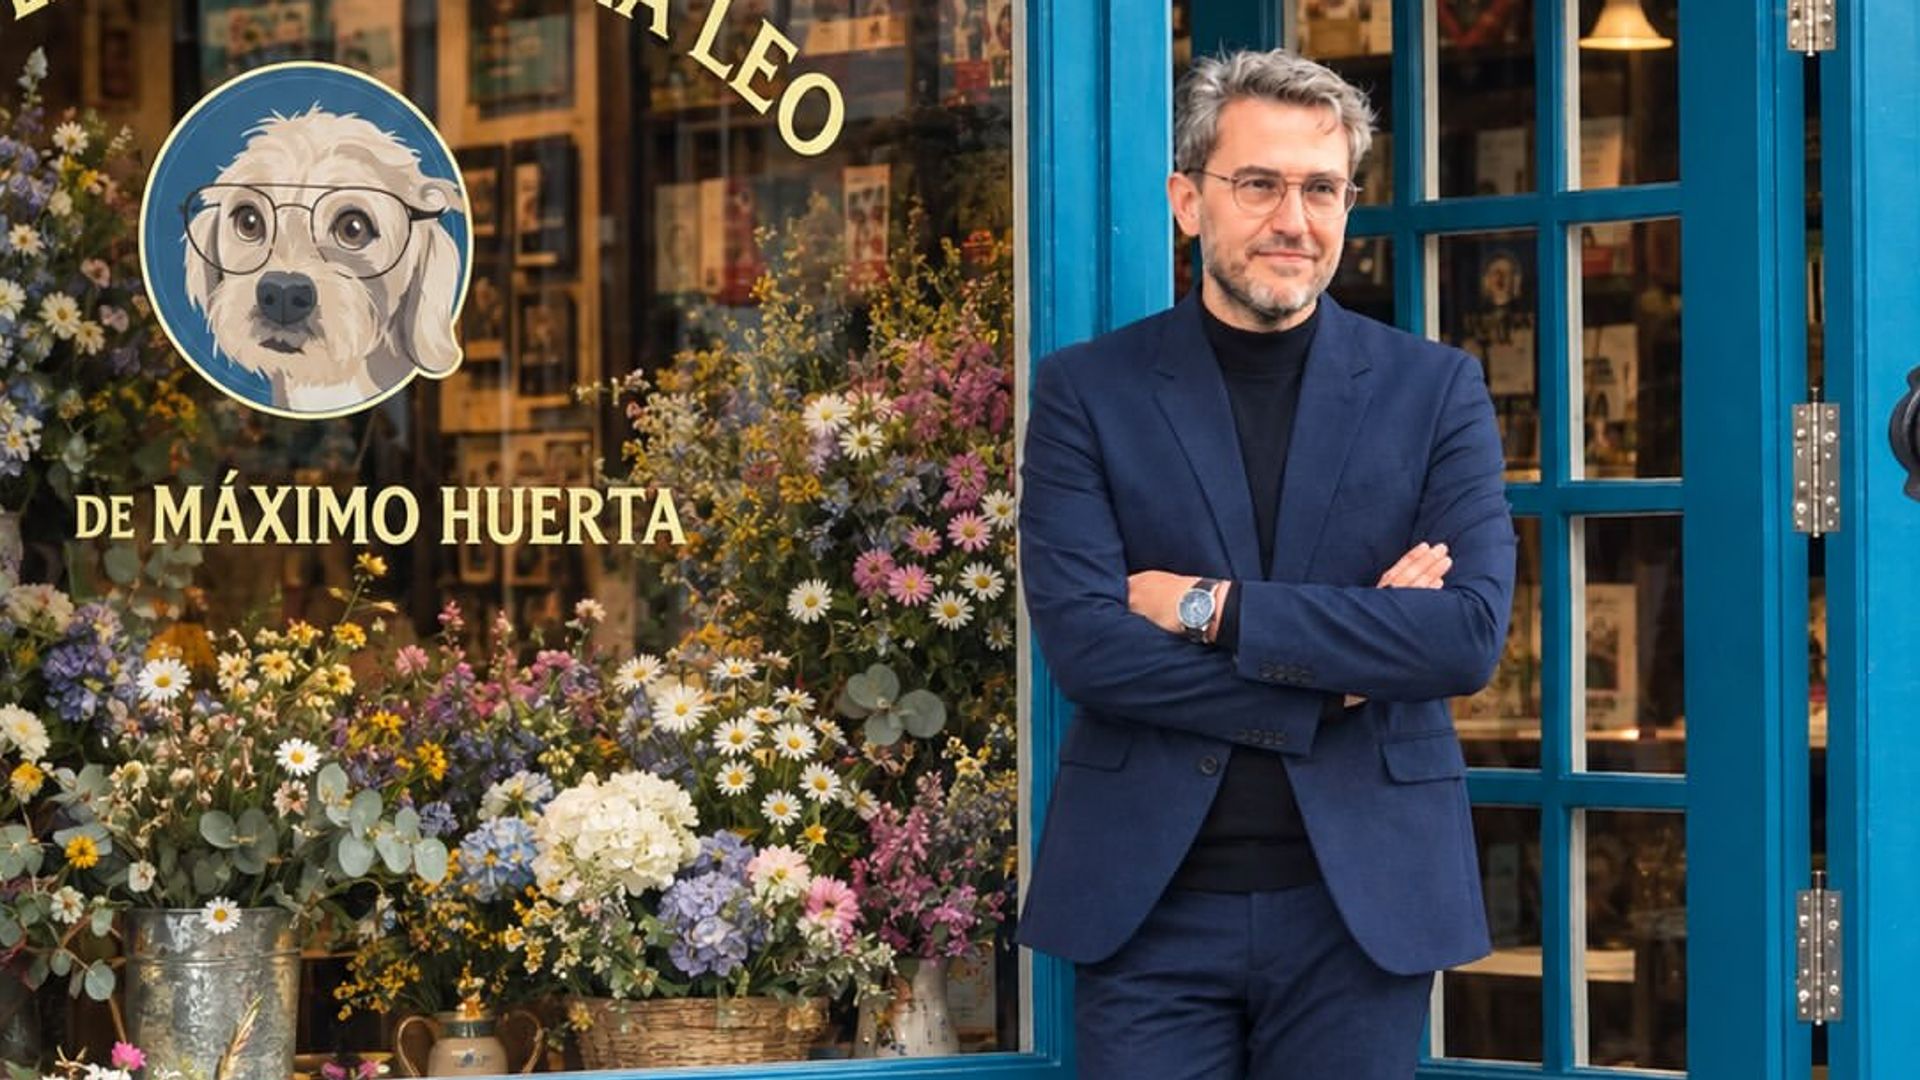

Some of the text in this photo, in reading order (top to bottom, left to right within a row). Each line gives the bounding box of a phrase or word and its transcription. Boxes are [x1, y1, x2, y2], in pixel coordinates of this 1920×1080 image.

[688, 0, 845, 156] LEO
[76, 470, 688, 545] DE MÁXIMO HUERTA
